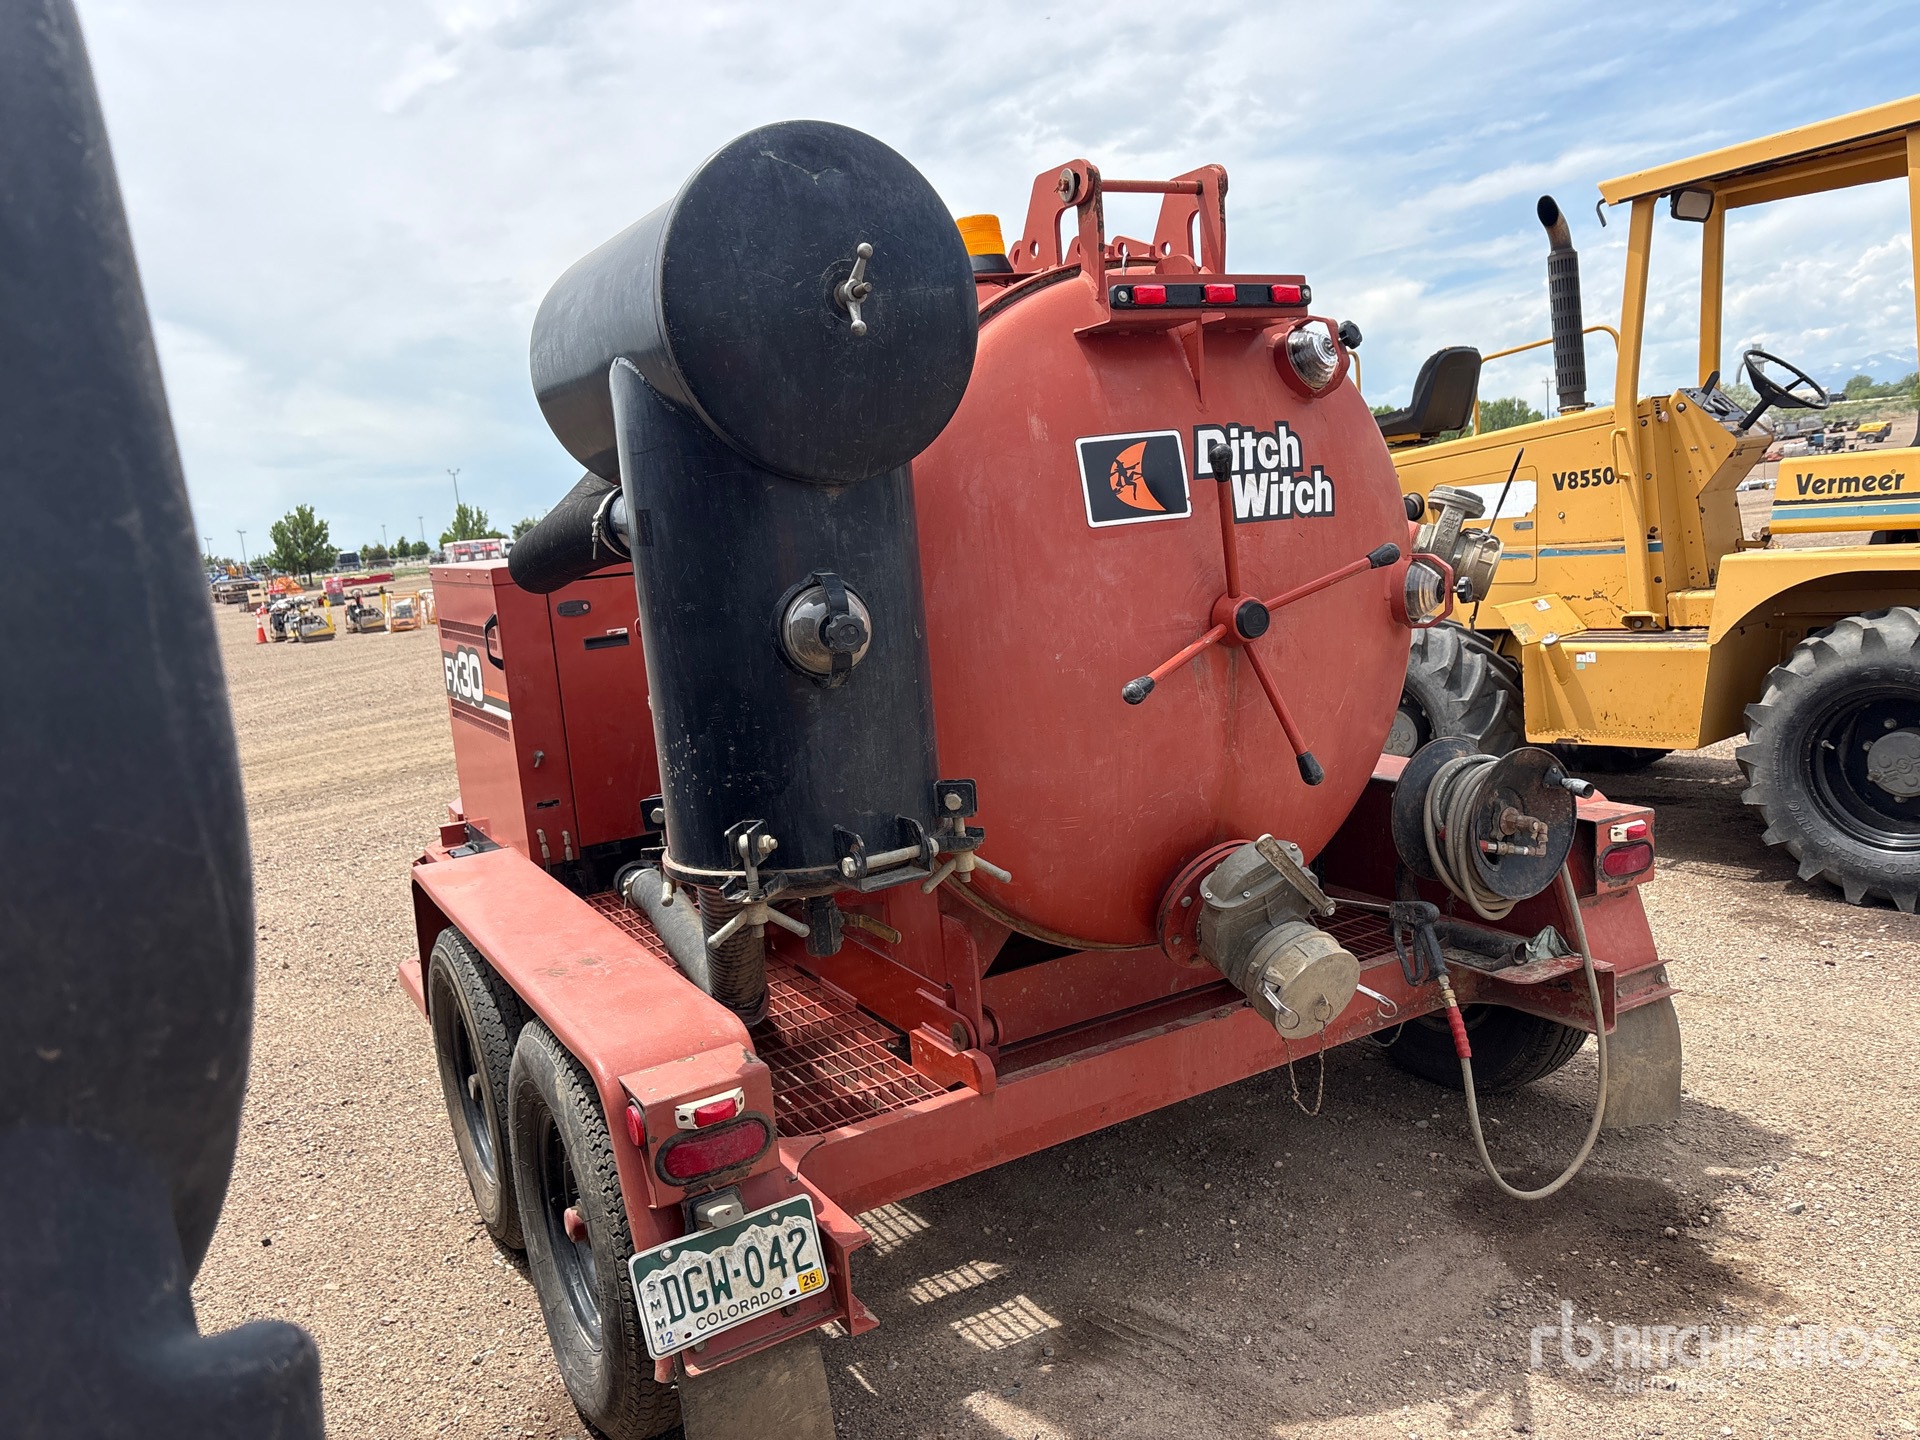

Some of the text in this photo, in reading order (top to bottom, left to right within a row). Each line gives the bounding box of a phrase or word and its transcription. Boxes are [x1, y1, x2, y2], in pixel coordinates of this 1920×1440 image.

[1197, 425, 1301, 475] Ditch
[1230, 470, 1333, 518] Witch
[1552, 466, 1619, 491] V8550
[1796, 473, 1905, 496] Vermeer
[444, 651, 484, 702] FX30
[802, 1272, 817, 1287] 26
[695, 1286, 783, 1330] COLORADO
[659, 1331, 674, 1346] 12
